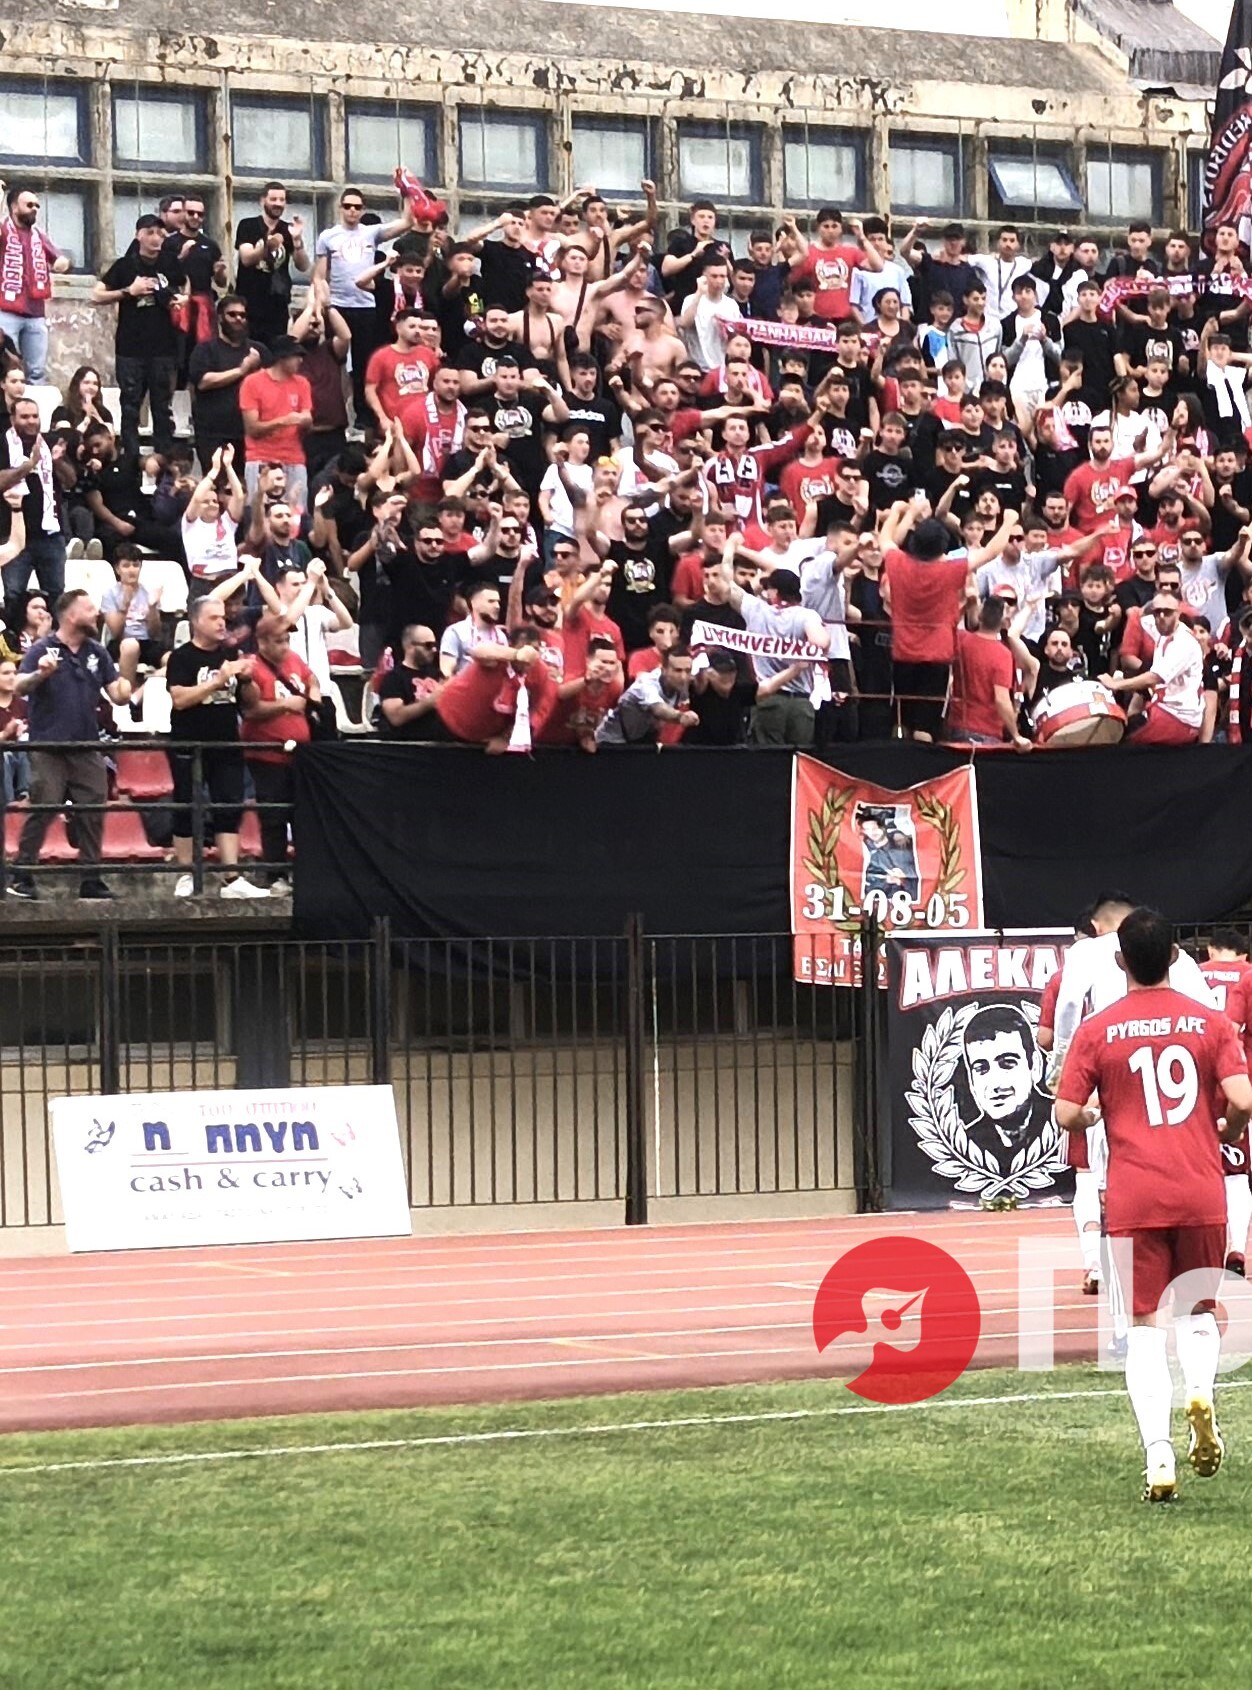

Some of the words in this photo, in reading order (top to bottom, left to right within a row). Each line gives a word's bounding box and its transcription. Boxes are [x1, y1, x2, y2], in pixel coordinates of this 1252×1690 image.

[802, 883, 970, 928] 31-08-05
[901, 949, 1072, 1007] ΑΛΕΚΑ
[1106, 1016, 1172, 1044] PYRGOS
[1174, 1015, 1207, 1035] AFC
[1128, 1044, 1199, 1127] 19
[130, 1167, 203, 1192] cash
[217, 1167, 240, 1189] &
[253, 1170, 332, 1193] carry
